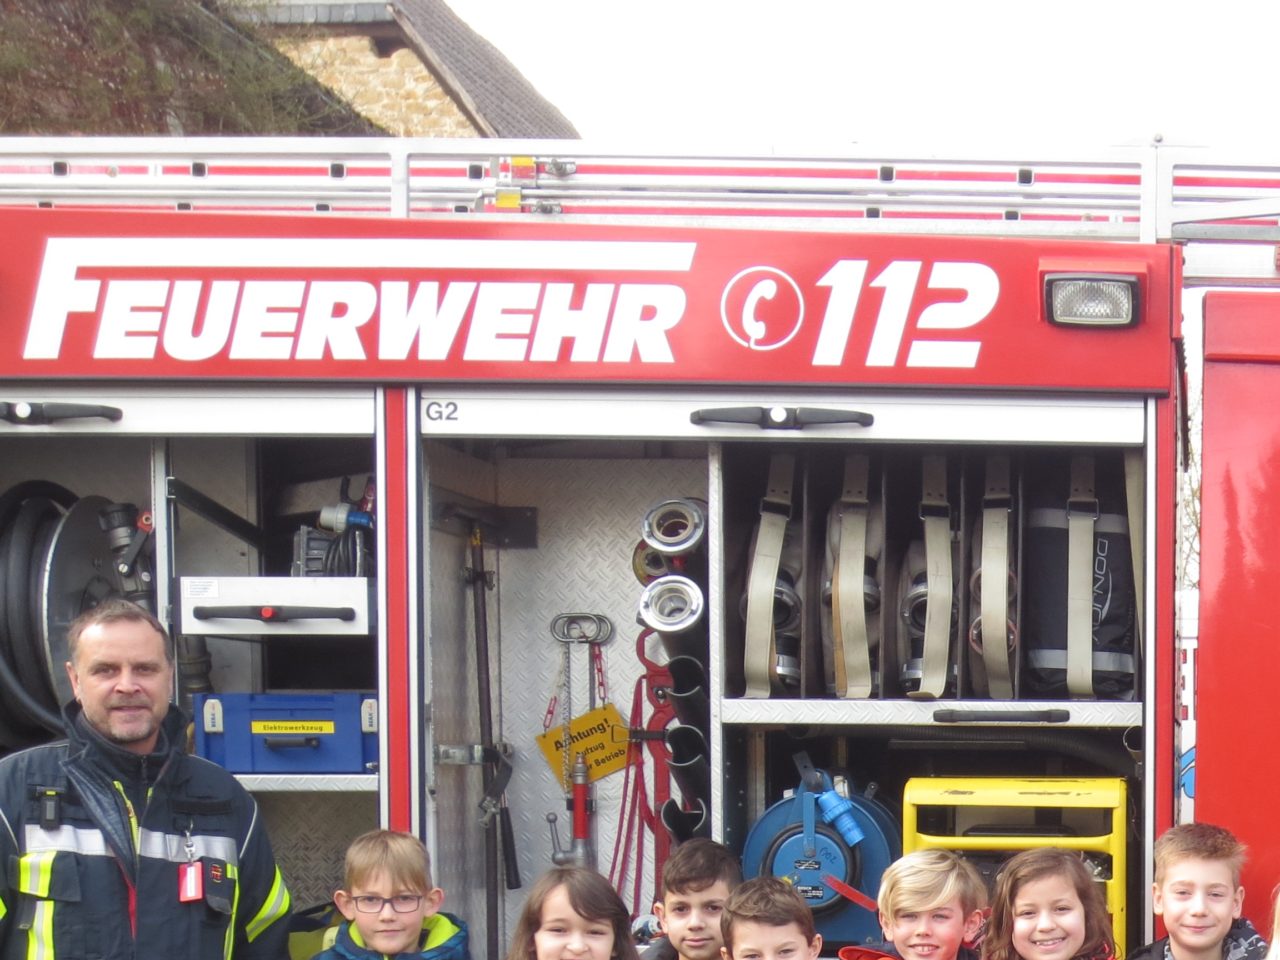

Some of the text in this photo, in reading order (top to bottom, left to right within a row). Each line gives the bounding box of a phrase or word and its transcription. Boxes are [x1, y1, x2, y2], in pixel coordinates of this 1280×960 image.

[22, 237, 1000, 368] FEUERWEHR 112
[426, 401, 458, 421] G2
[263, 724, 323, 732] Elektrowerkzeug
[594, 748, 626, 767] Betrieb
